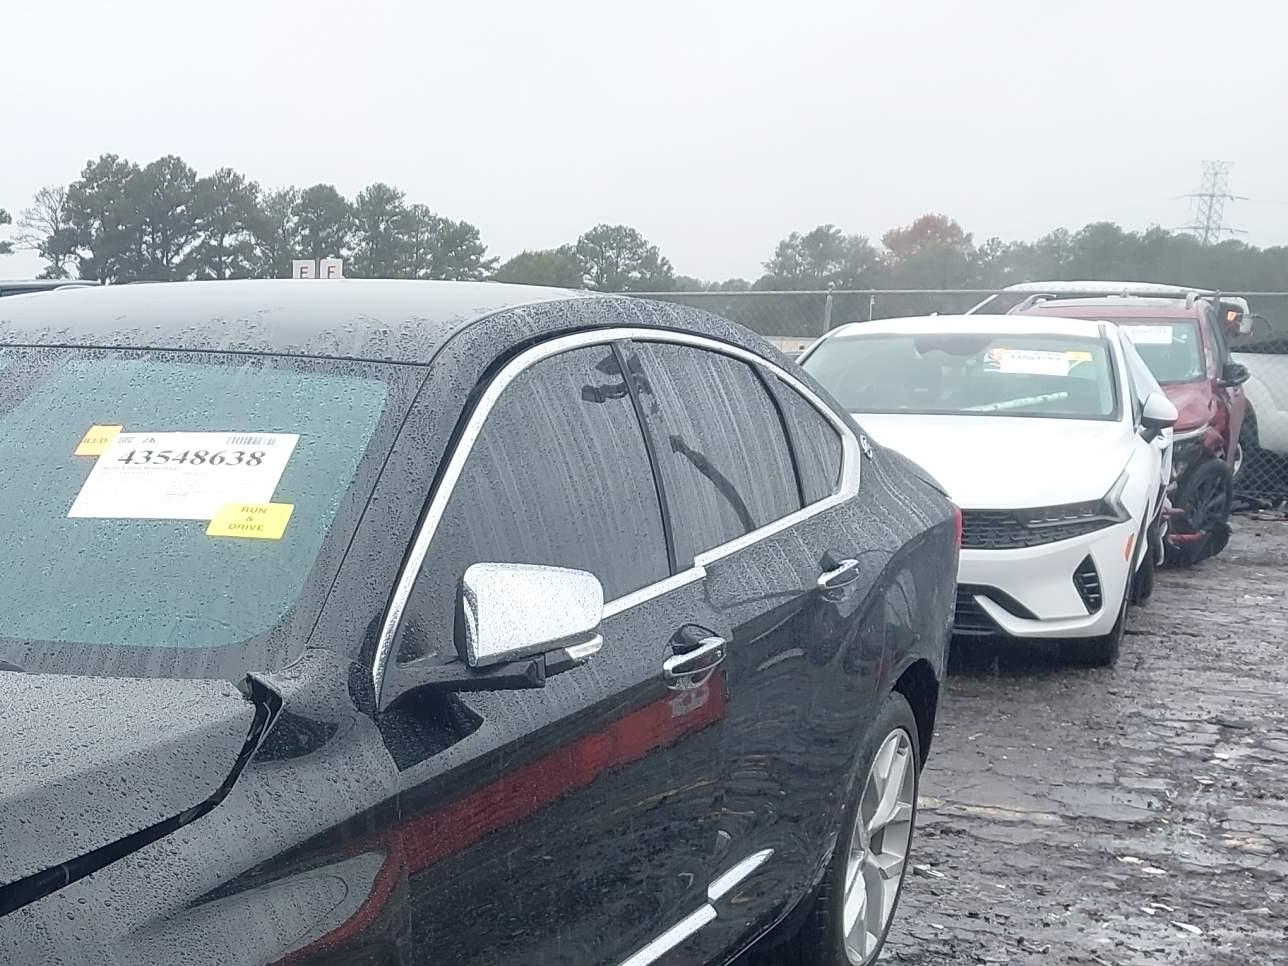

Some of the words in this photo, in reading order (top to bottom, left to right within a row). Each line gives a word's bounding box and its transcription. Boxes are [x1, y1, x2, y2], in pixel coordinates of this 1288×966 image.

[117, 449, 267, 467] 43548638
[240, 506, 268, 514] RUN
[227, 523, 265, 532] DRIVE
